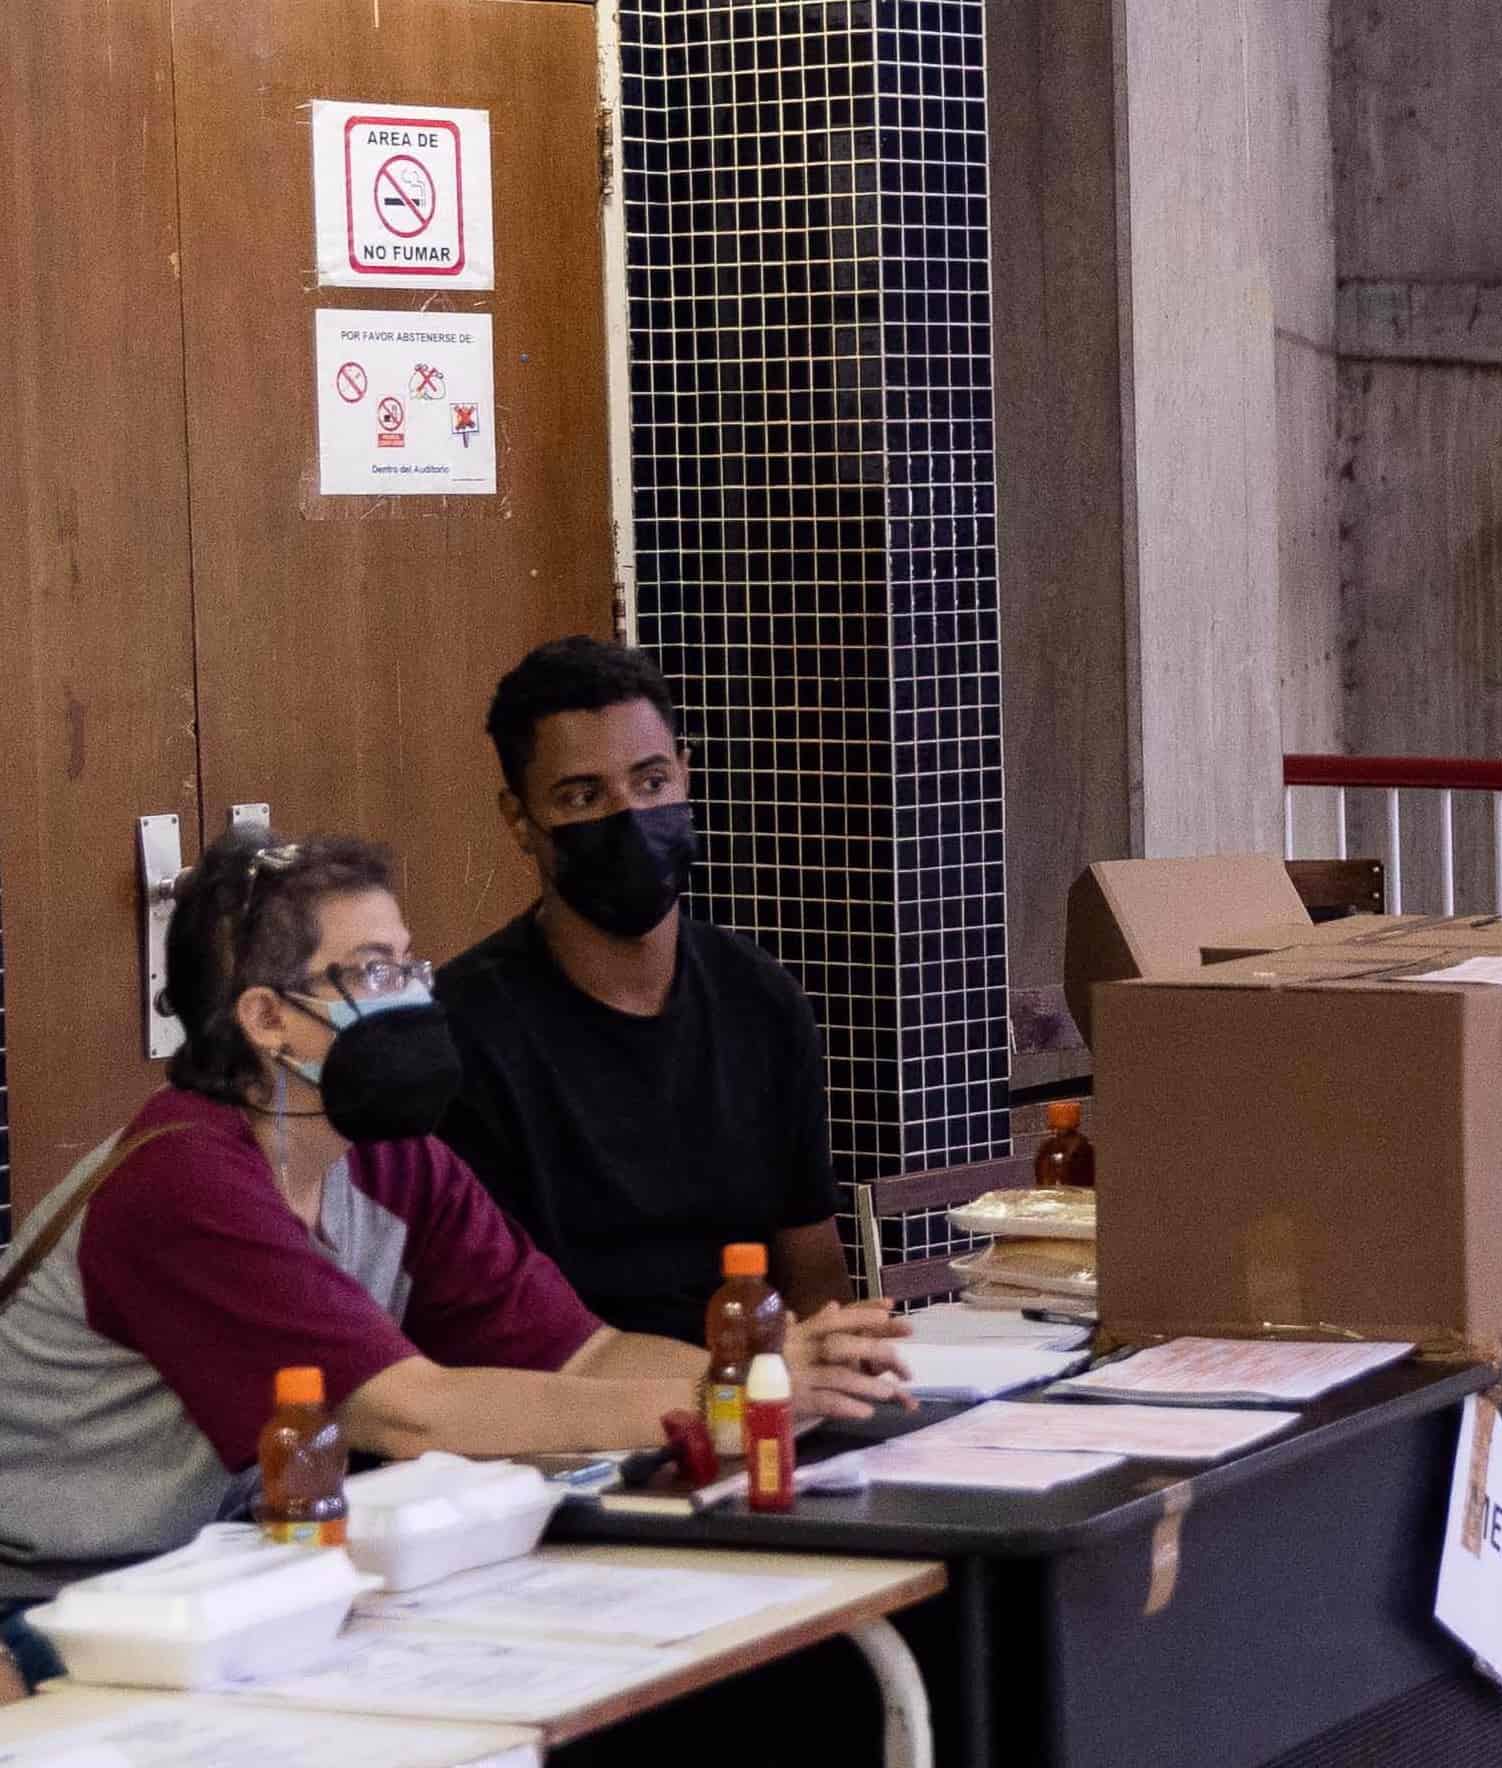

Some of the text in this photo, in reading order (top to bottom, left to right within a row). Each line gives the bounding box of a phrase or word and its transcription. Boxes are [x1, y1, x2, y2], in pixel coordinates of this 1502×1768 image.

[367, 130, 439, 148] AREA DE
[363, 245, 451, 262] NO FUMAR
[340, 330, 361, 341] POR
[363, 330, 394, 342] FAVOR
[397, 332, 457, 344] ABSTENERSE
[372, 464, 449, 474] Dentro del Auditorio
